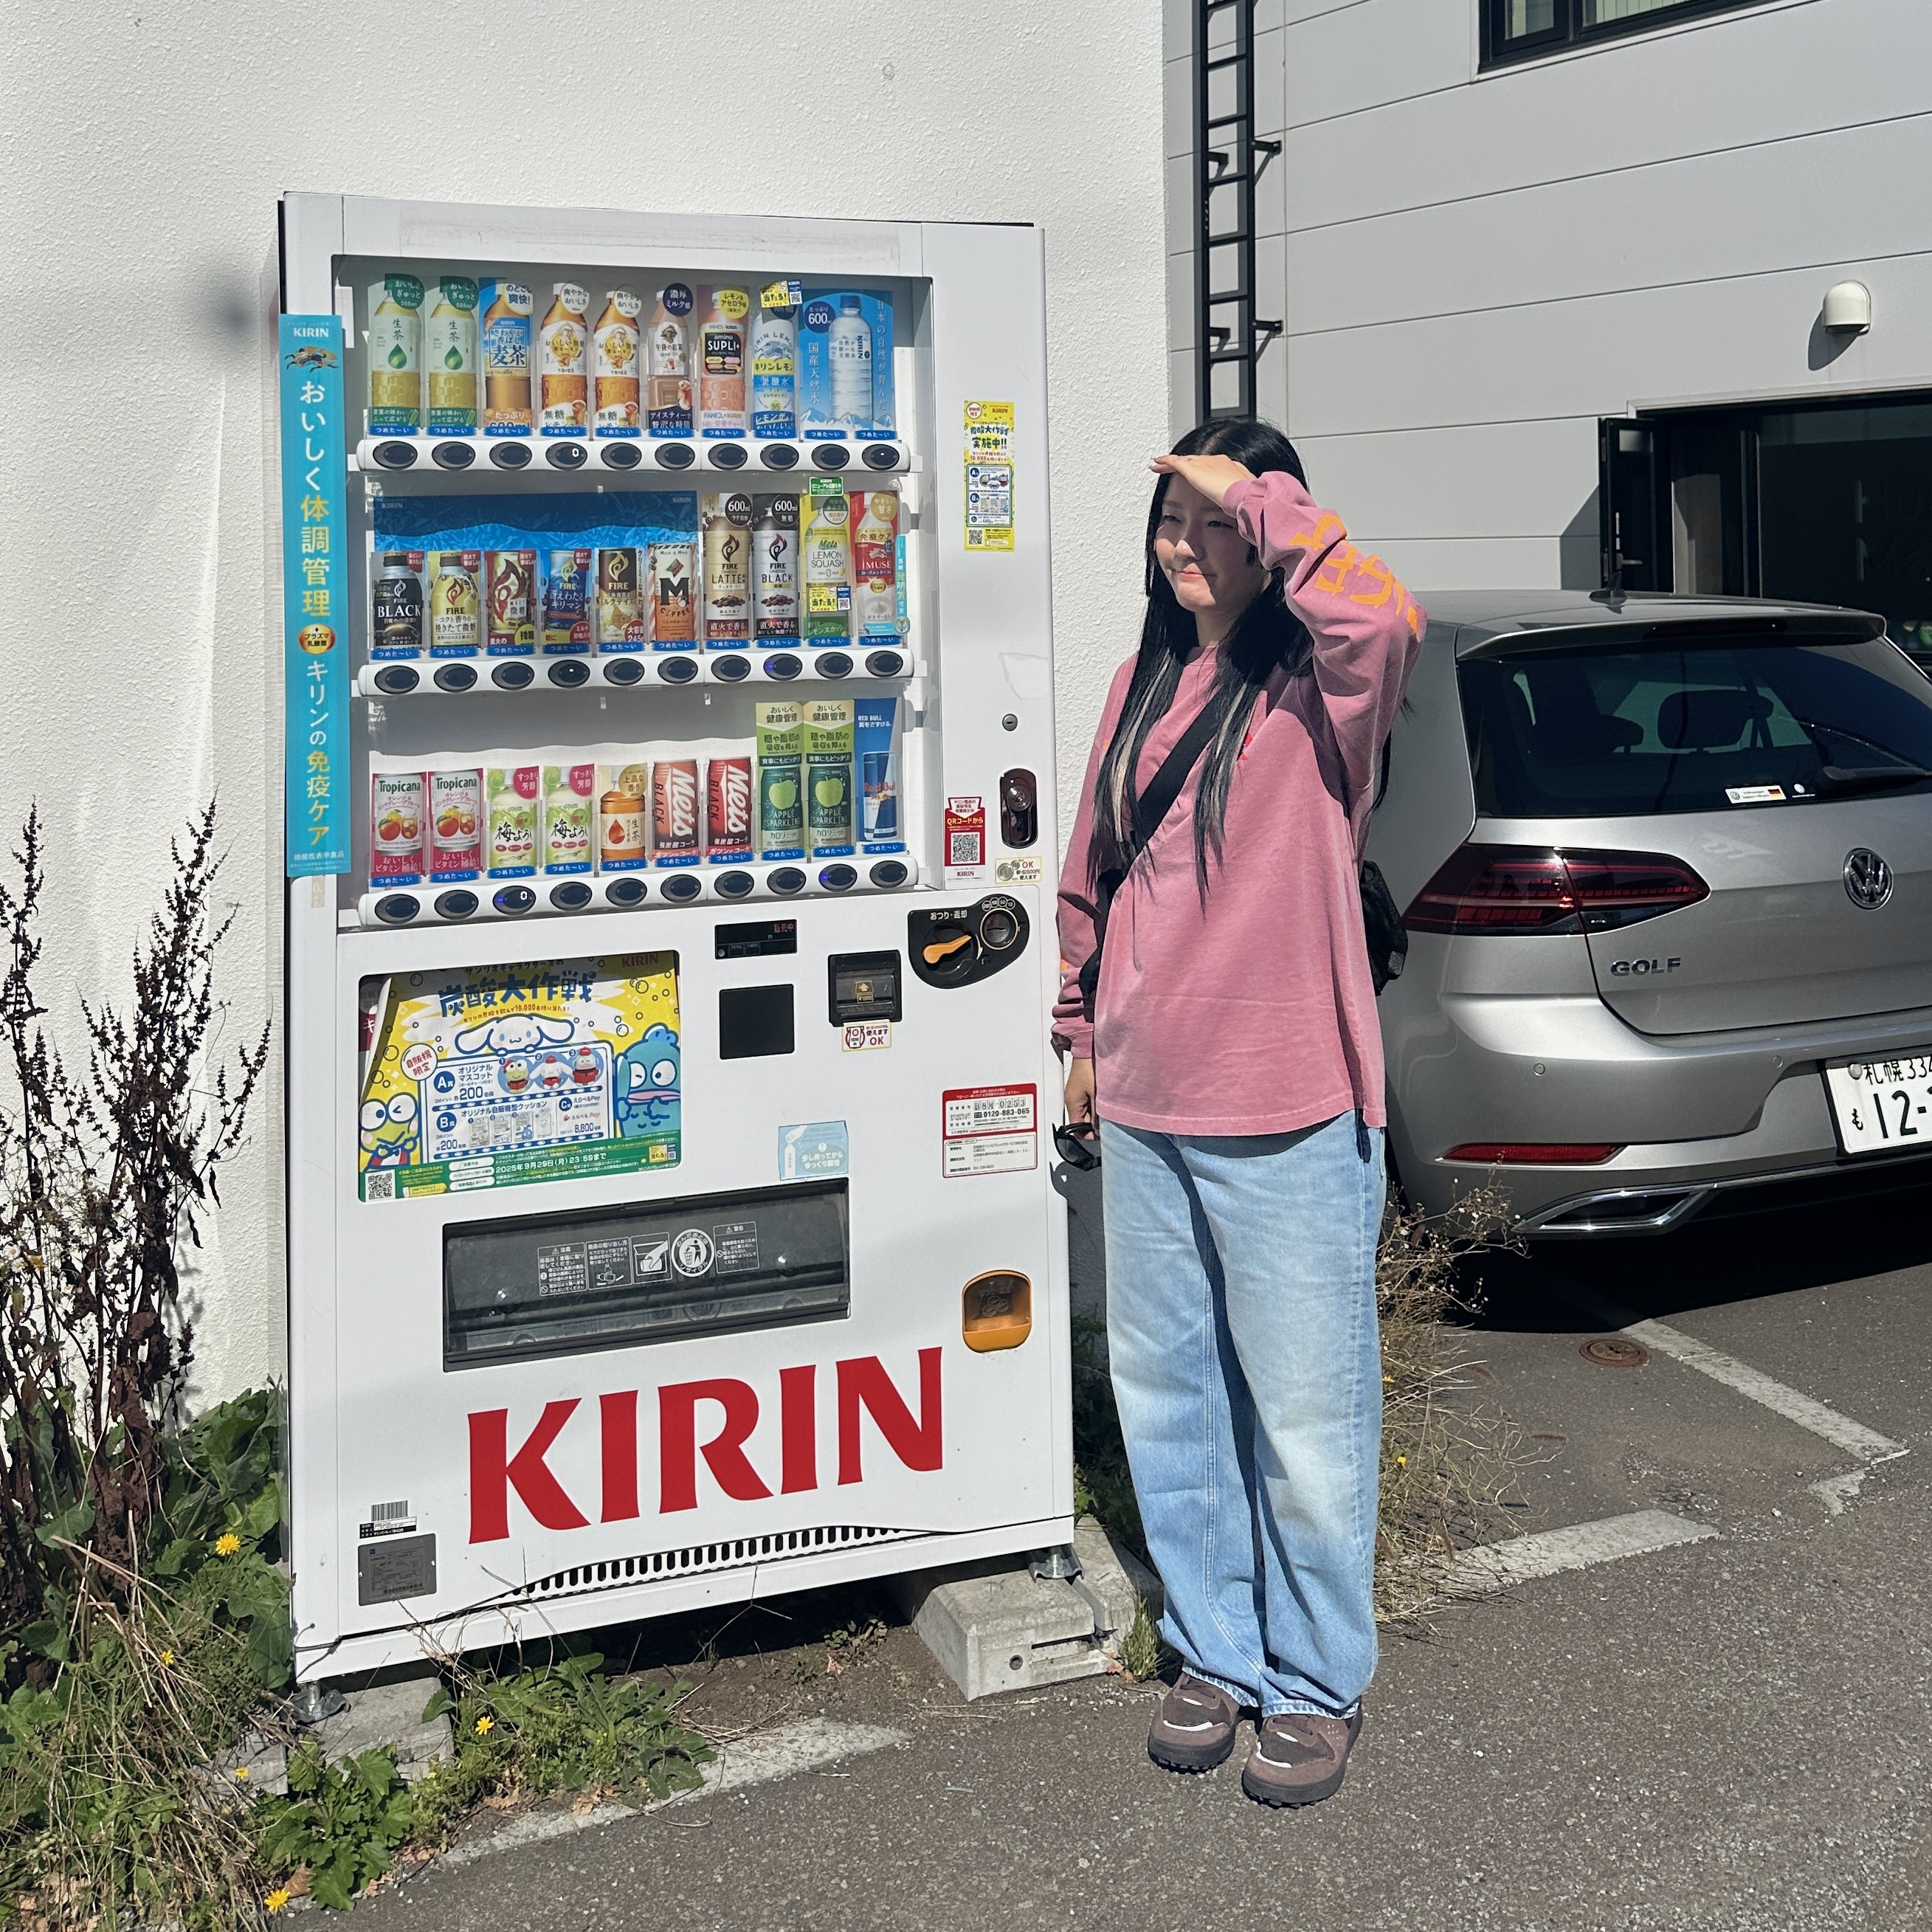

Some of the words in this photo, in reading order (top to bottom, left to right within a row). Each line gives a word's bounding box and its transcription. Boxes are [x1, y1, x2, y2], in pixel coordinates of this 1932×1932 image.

[396, 289, 421, 298] ぎゅっと
[452, 291, 475, 300] ぎゅっと
[564, 289, 588, 297] 爽やかな
[669, 289, 687, 299] 濃厚
[508, 294, 531, 305] 爽快!
[294, 328, 329, 337] KIRIN
[393, 318, 404, 342] 生茶
[449, 320, 460, 342] 生茶
[491, 345, 525, 366] 麦茶
[809, 342, 821, 404] 国産天然水
[761, 376, 788, 386] 炭酸水
[495, 411, 525, 419] たっぷり
[545, 410, 565, 420] 無糖
[598, 412, 617, 421] 無糖
[972, 438, 1007, 449] 実施中!!
[300, 380, 331, 617] おいしく体調管理
[728, 500, 751, 511] 600ml
[775, 500, 798, 511] 600ml
[877, 506, 892, 514] 甘さ
[860, 533, 891, 541] 免疫ケア
[813, 551, 841, 559] LEMON
[812, 559, 843, 567] SQUASH
[862, 561, 891, 570] iMUSE
[711, 573, 741, 584] LATTE
[762, 573, 793, 583] BLACK
[550, 590, 584, 601] 冴えわたる
[552, 601, 582, 610] キリマン
[377, 605, 421, 617] BLACK
[435, 623, 476, 633] 挽きたて微糖
[770, 705, 794, 714] おいしく
[766, 713, 798, 723] 健康管理
[813, 712, 846, 722] 健康管理
[764, 732, 799, 743] 糖や脂肪の
[810, 731, 849, 742] 糖や脂肪の
[766, 743, 798, 751] 吸収を抑える
[813, 741, 847, 750] 吸収を抑える
[306, 660, 330, 846] キリンの免疫ケア
[762, 756, 801, 765] 食事にもピッタリ
[435, 776, 477, 791] Tropicana
[623, 775, 644, 784] 上品な
[379, 780, 421, 795] Tropicana
[627, 783, 640, 792] 香り
[863, 782, 881, 792] Red
[655, 782, 664, 824] BLACK
[672, 767, 695, 837] Mets
[710, 779, 720, 820] BLACK
[727, 764, 750, 834] Mets
[773, 809, 796, 818] APPLE
[819, 807, 841, 817] APPLE
[765, 817, 801, 827] SPARKLING
[947, 817, 984, 826] QRコードから
[494, 821, 532, 842] 梅よろし
[551, 818, 588, 839] 梅よろし
[631, 818, 640, 841] 生茶
[659, 838, 696, 848] 強炭酸コーラ
[714, 836, 748, 845] 強炭酸コーラ
[294, 850, 345, 861] 機能性表示食品
[382, 855, 415, 864] おいしく
[441, 851, 473, 860] おいしく
[622, 953, 659, 967] KIRIN
[1610, 957, 1681, 976] GOLF
[439, 970, 593, 1018] 炭酸大作戦
[869, 1036, 884, 1045] OK
[406, 1049, 432, 1069] 自販機
[413, 1062, 430, 1077] 限定
[458, 1063, 494, 1074] オリジナル
[1863, 1058, 1904, 1086] 札幌
[458, 1072, 493, 1083] マスコット
[1852, 1108, 1863, 1131] も
[1873, 1086, 1932, 1139] 12-
[468, 1346, 943, 1544] KIRIN
